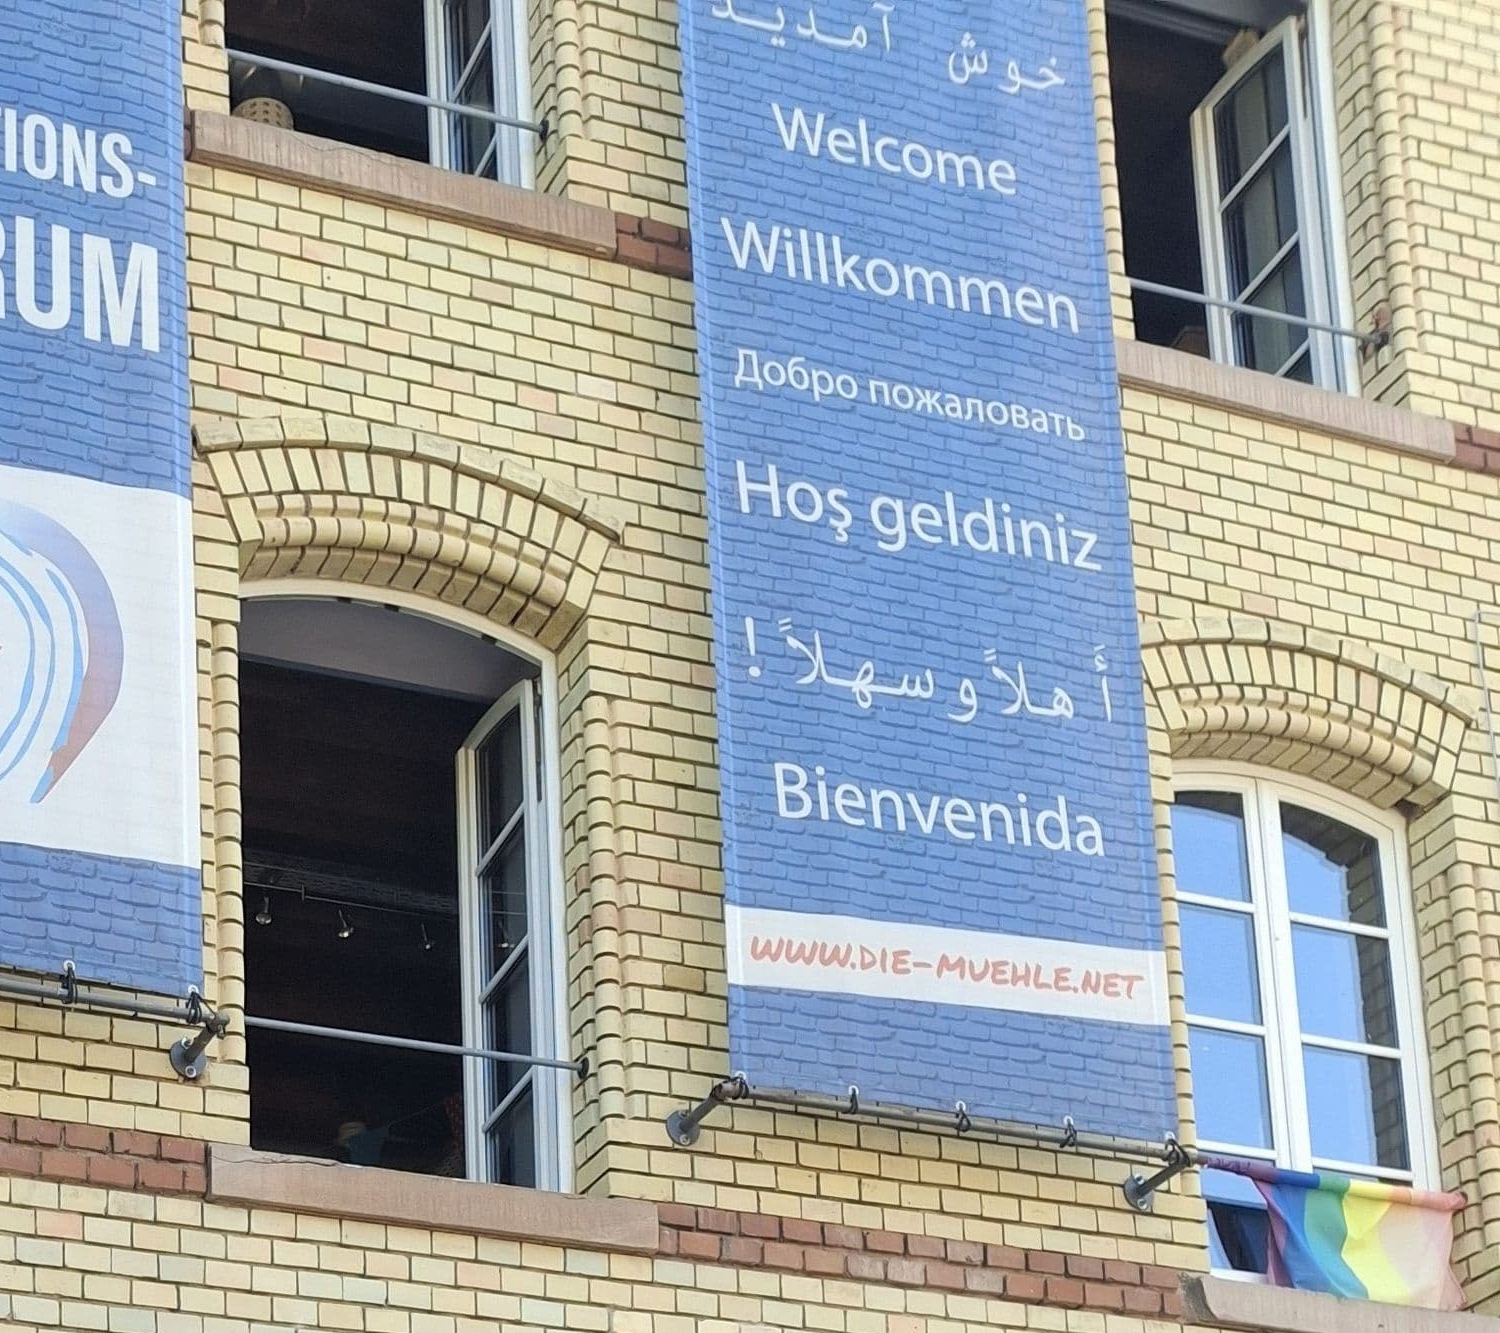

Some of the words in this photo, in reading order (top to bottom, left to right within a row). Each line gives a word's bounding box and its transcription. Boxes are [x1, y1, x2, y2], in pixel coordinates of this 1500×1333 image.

[772, 103, 1017, 195] Welcome
[720, 217, 1079, 334] Willkommen
[734, 348, 858, 400] Добро
[870, 378, 1086, 441] пожаловать
[735, 459, 853, 544] Hoş
[870, 491, 1102, 570] geldiniz
[773, 762, 1106, 857] Bienvenida
[750, 935, 1145, 1000] WWW.DIE-MUEHLE.NET
